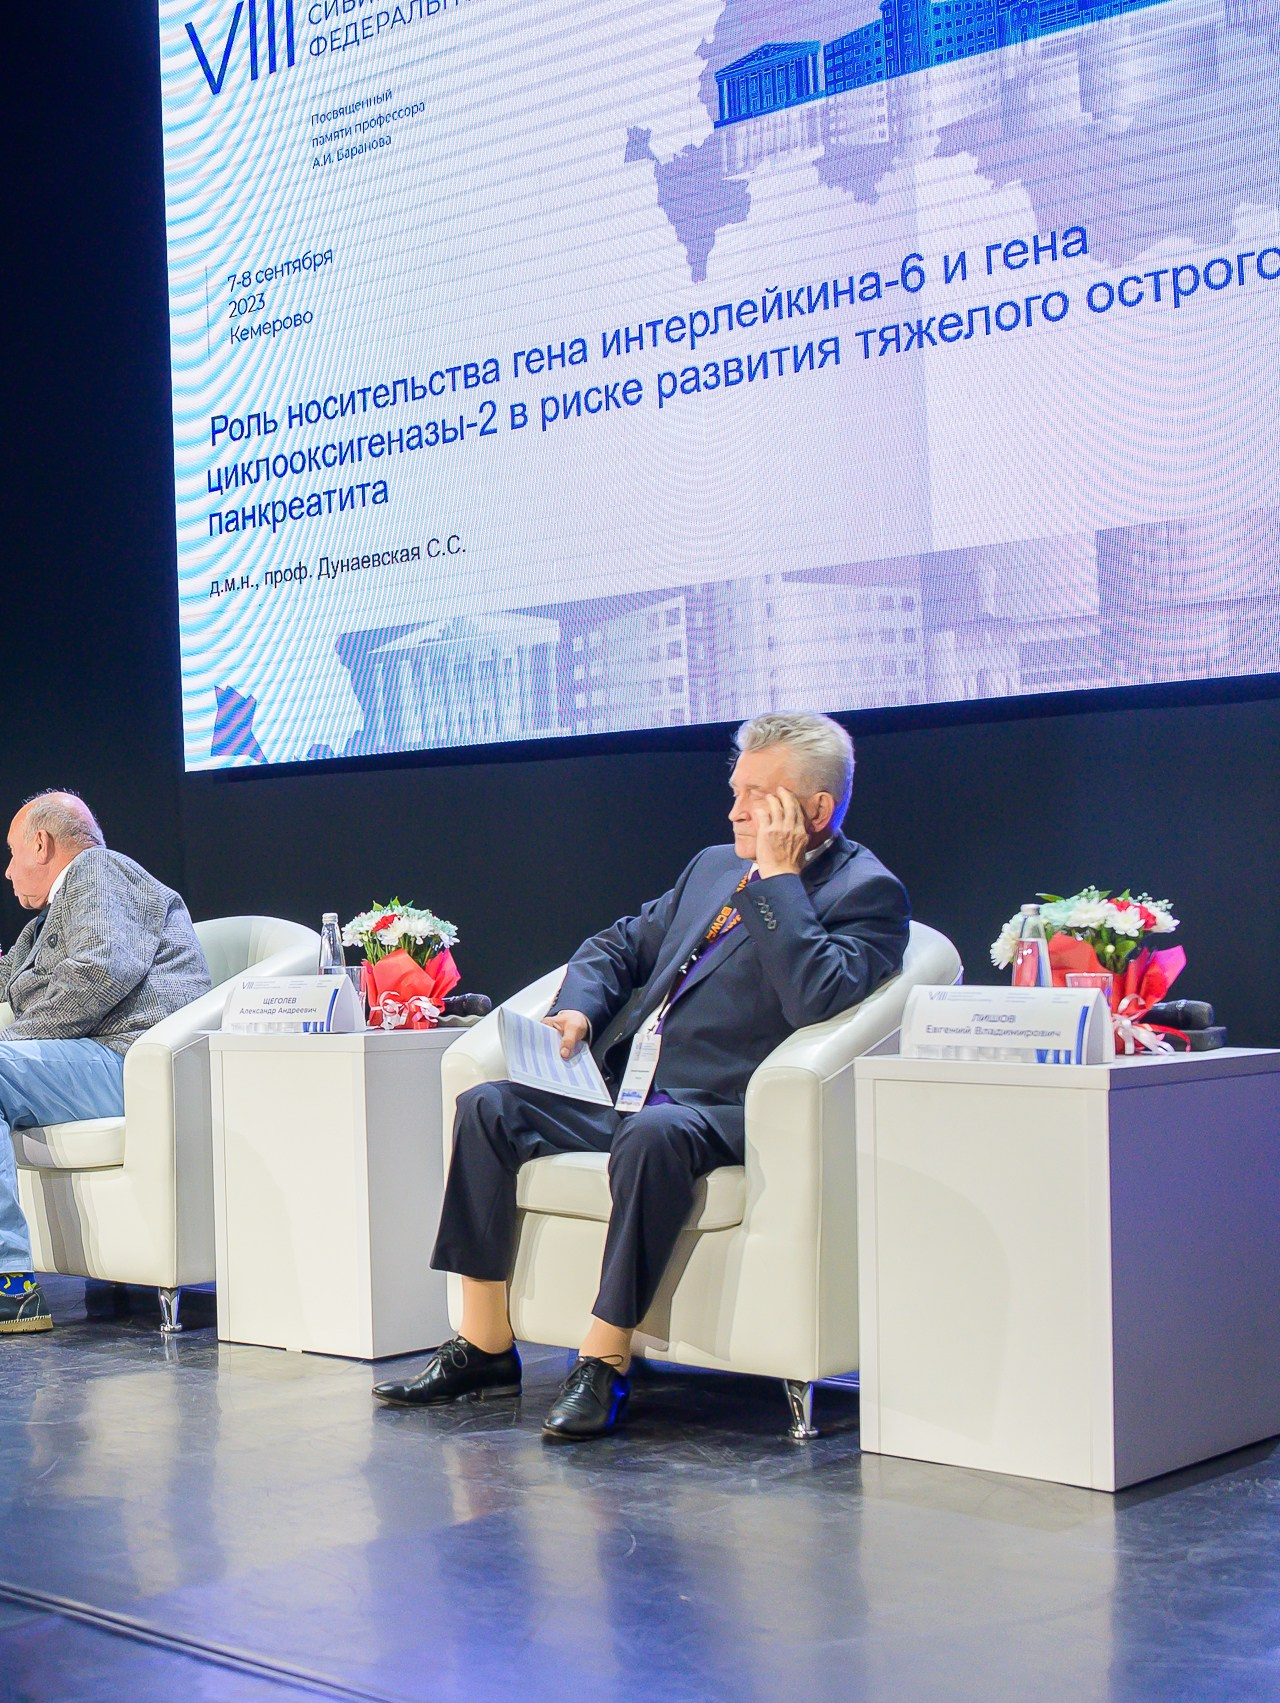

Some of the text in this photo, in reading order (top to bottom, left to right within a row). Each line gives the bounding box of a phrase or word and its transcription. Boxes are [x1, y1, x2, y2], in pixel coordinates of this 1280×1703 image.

[185, 0, 295, 95] VIII
[311, 88, 393, 127] Посвященный
[312, 101, 426, 148] памяти профессора
[312, 135, 392, 170] А.И. Баранова
[227, 248, 334, 293] 7-8 сентября
[228, 293, 266, 319] 2023
[229, 308, 314, 345] Кемерово
[209, 224, 1090, 447] Роль носительства гена интерлейкина-6 и гена
[206, 247, 1280, 495] циклооксигеназы-2 в риске развития тяжелого острого
[208, 478, 390, 538] панкреатита
[209, 533, 467, 598] д.м.н., проф. Дунаевская С.С.
[239, 1007, 317, 1015] Александр Андреевич
[262, 997, 297, 1005] ЩЕГОЛЕВ
[926, 1024, 1061, 1038] Евгений Владимирович
